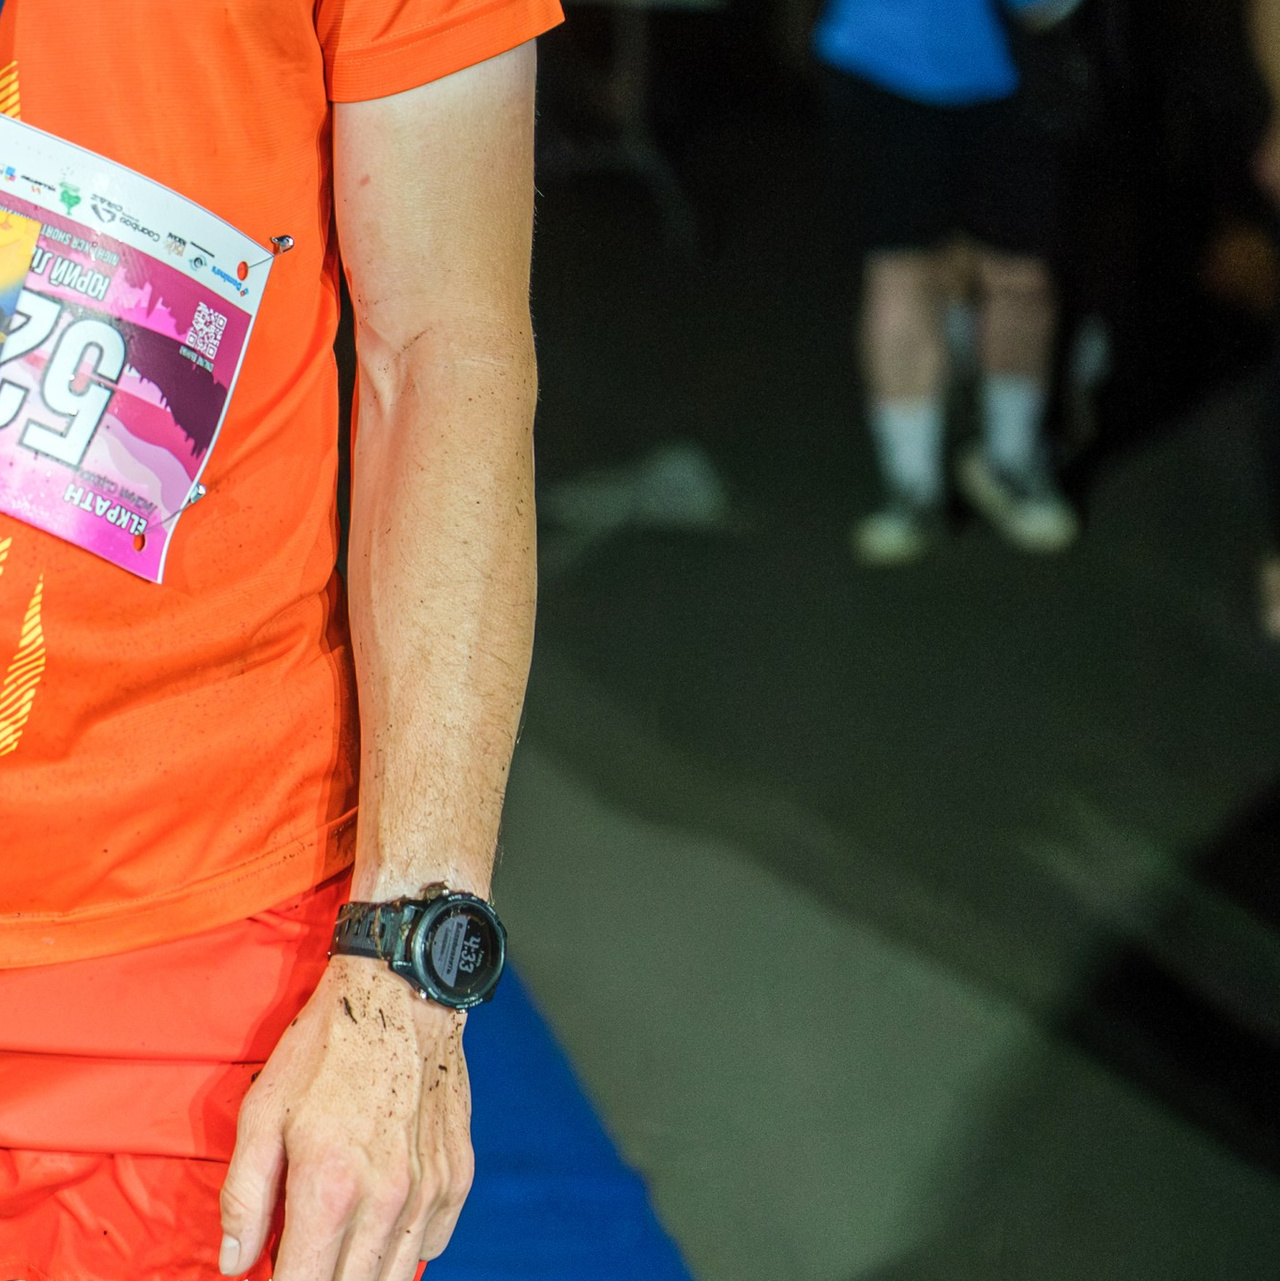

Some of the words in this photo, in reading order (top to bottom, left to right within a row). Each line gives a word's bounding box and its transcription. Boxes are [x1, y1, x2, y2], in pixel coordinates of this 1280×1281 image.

[51, 256, 110, 301] ЮРИЙ
[63, 482, 147, 535] ELKPATH
[460, 936, 481, 973] 4:33
